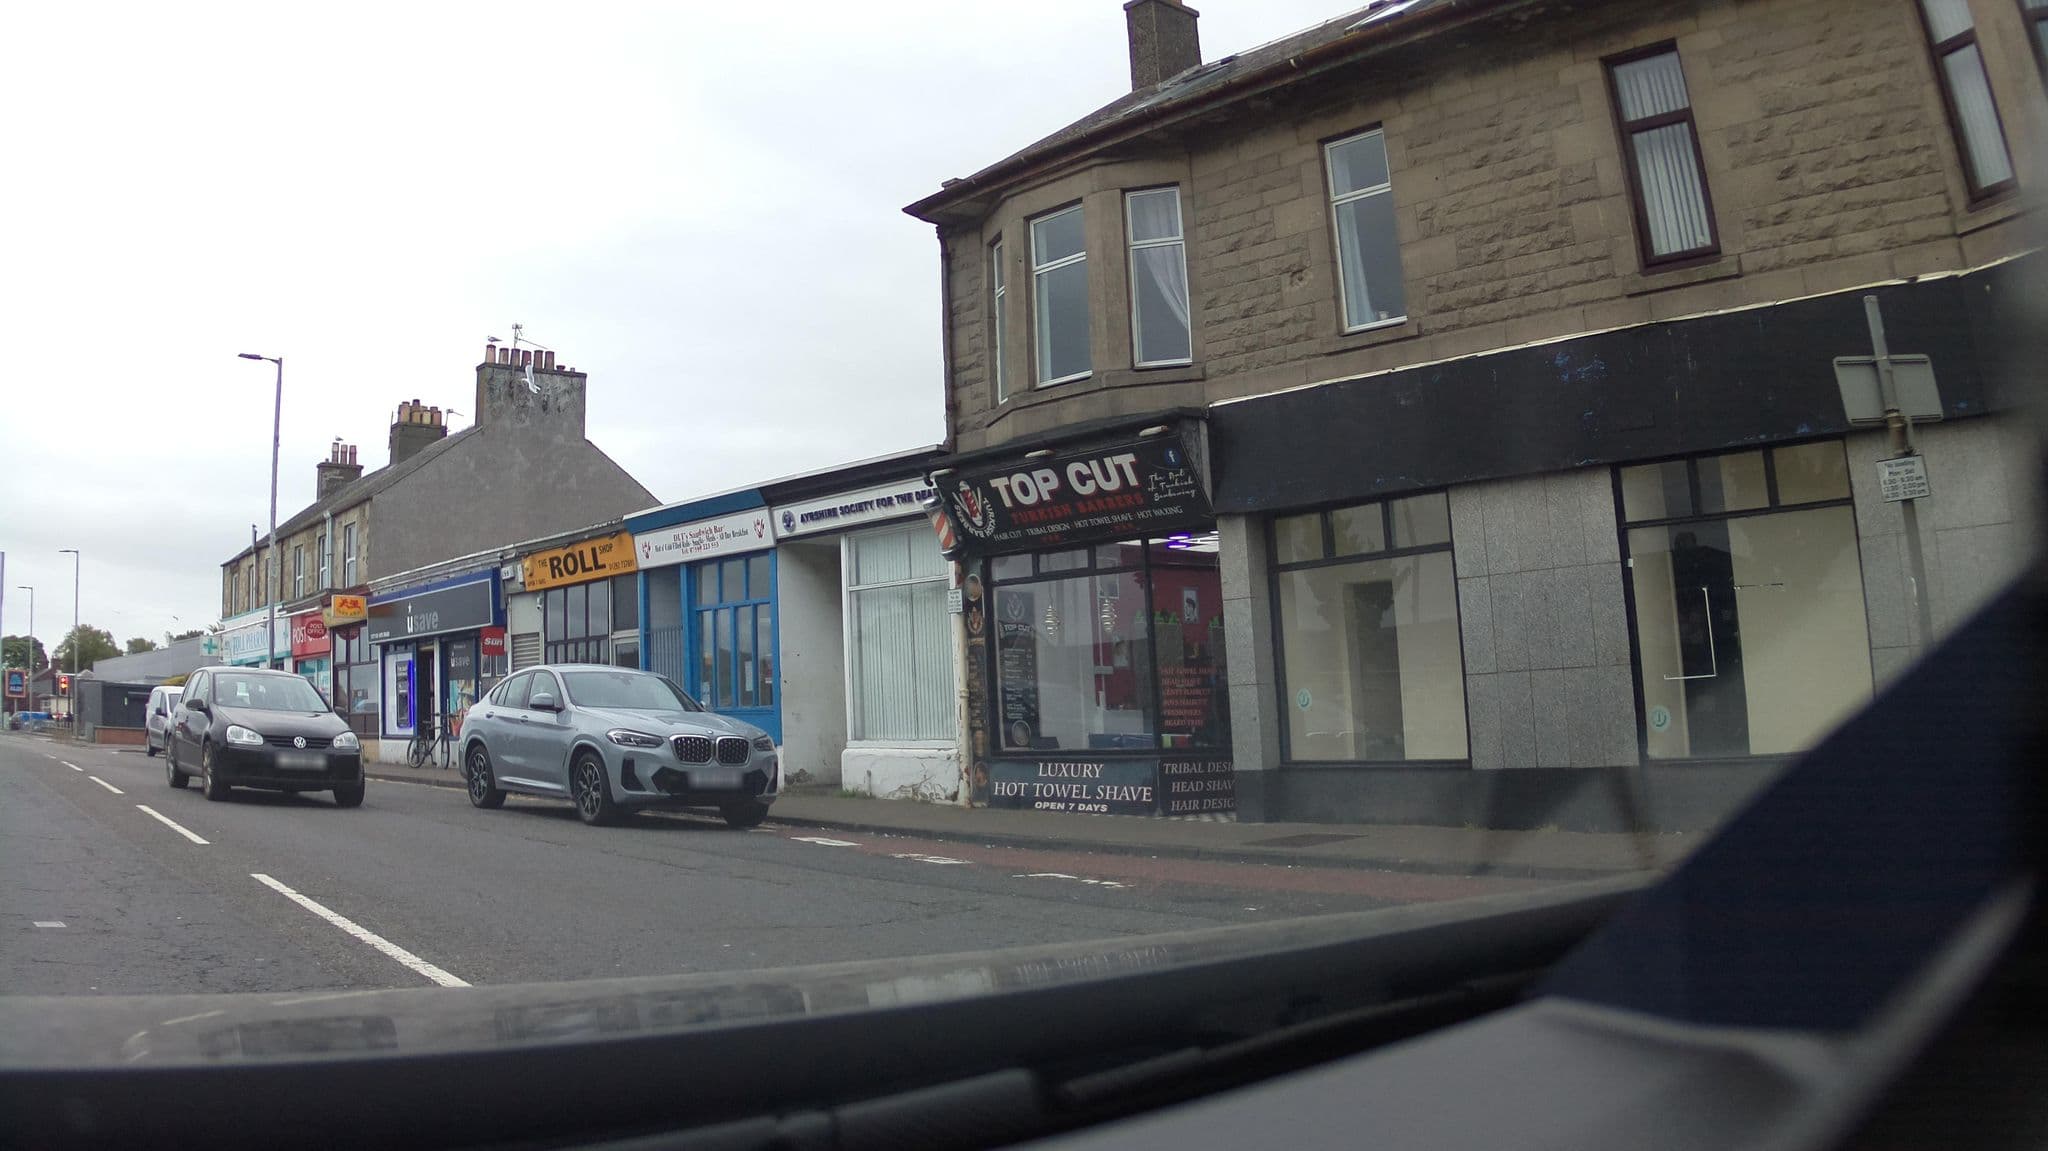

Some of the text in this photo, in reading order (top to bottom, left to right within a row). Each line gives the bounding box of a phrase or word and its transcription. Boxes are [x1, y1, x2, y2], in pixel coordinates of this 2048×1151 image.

[989, 453, 1139, 508] TOP CUT
[800, 508, 838, 523] AYRSHIRE
[839, 500, 874, 515] SOCIETY
[876, 496, 894, 508] FOR
[895, 492, 914, 504] THE
[1137, 510, 1152, 518] HOT
[1153, 506, 1183, 516] WAXING
[538, 544, 614, 578] THE ROLL SHOP
[292, 626, 306, 644] POST
[1038, 762, 1104, 778] LUXURY
[1163, 763, 1204, 774] TRIBAL
[994, 782, 1152, 802] HOT TOWEL SHAVE
[1172, 780, 1234, 792] HEAD SHAV
[1035, 801, 1108, 812] OPEN 7 DAYS
[1172, 798, 1234, 812] HAIR DESIG
